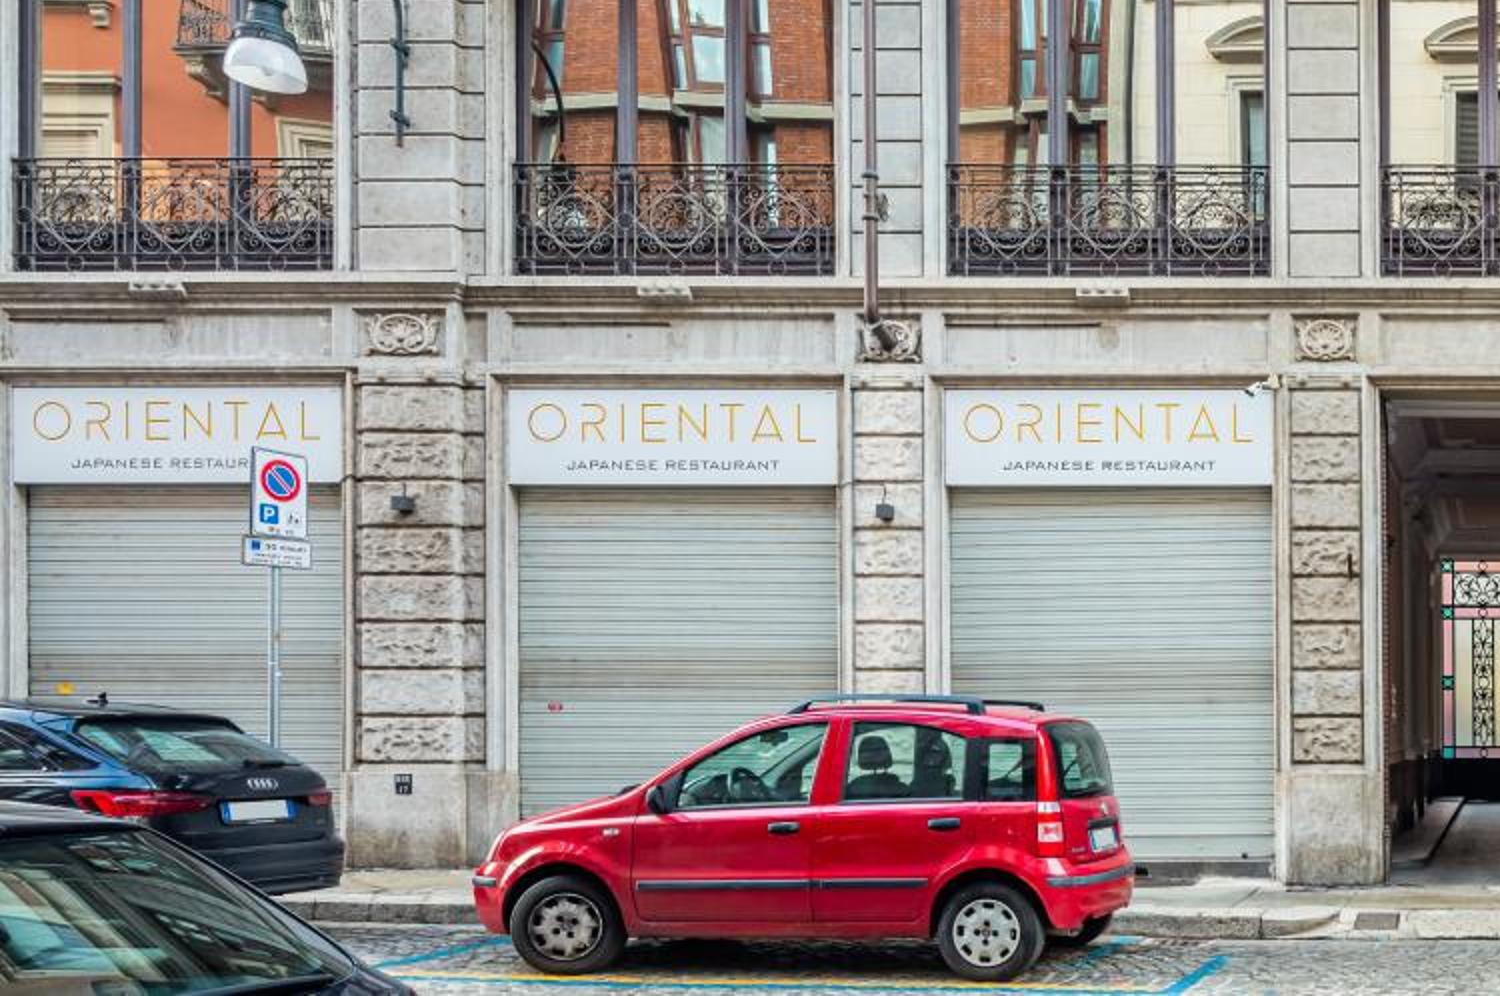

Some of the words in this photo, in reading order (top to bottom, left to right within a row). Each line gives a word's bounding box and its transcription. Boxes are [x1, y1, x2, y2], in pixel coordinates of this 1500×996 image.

[33, 401, 321, 441] ORIENTAL
[528, 403, 817, 443] ORIENTAL
[964, 403, 1253, 443] ORIENTAL
[71, 458, 163, 469] JAPANESE
[170, 458, 250, 470] RESTAUR
[567, 460, 657, 471] JAPANESE
[665, 460, 779, 471] RESTAURANT
[1003, 460, 1094, 471] JAPANESE
[1101, 460, 1215, 471] RESTAURANT
